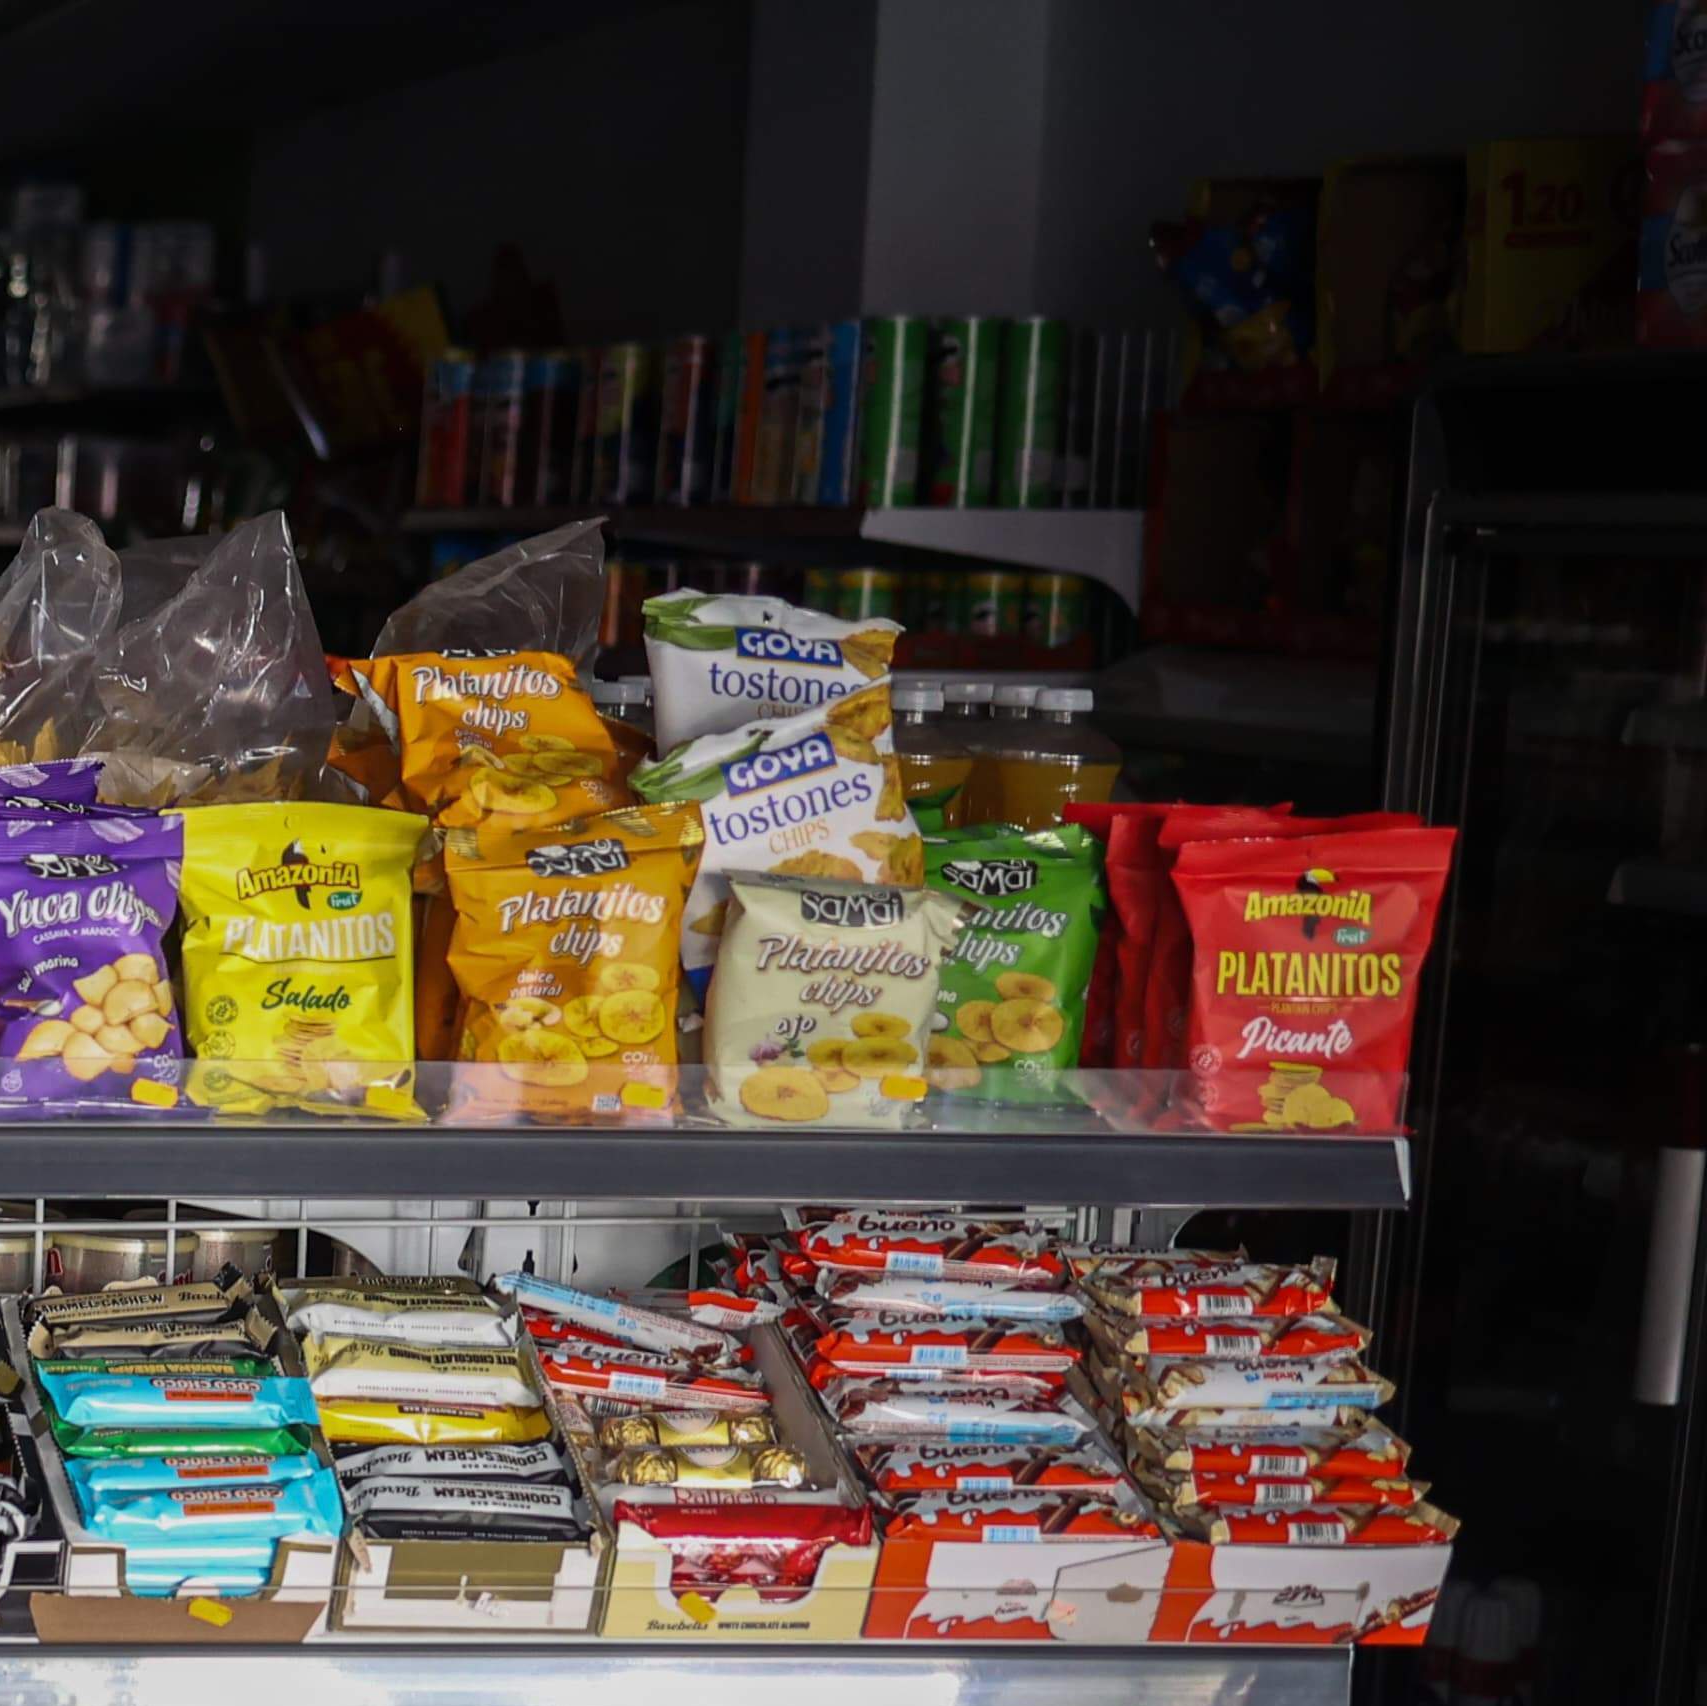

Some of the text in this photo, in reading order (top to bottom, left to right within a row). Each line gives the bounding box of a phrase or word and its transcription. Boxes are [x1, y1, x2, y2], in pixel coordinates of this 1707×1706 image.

[739, 628, 843, 666] GOYA
[413, 664, 561, 704] Platanitos
[461, 701, 526, 732] chips
[725, 734, 835, 795] GOYA
[707, 774, 872, 846] tostones
[767, 820, 832, 853] CHIPS
[498, 884, 664, 924] Platanitos
[223, 911, 395, 960] PLATANITOS
[548, 928, 623, 963] chips
[757, 938, 931, 976] Platanitos
[1217, 952, 1401, 996] PLATANITOS
[261, 976, 352, 1013] Salado
[800, 978, 879, 1012] chips
[772, 1012, 818, 1040] ajo
[1237, 1016, 1353, 1058] Picante
[858, 1215, 956, 1234] bueno
[582, 1346, 679, 1367] bueno
[152, 1377, 262, 1391] COCO CHOCO
